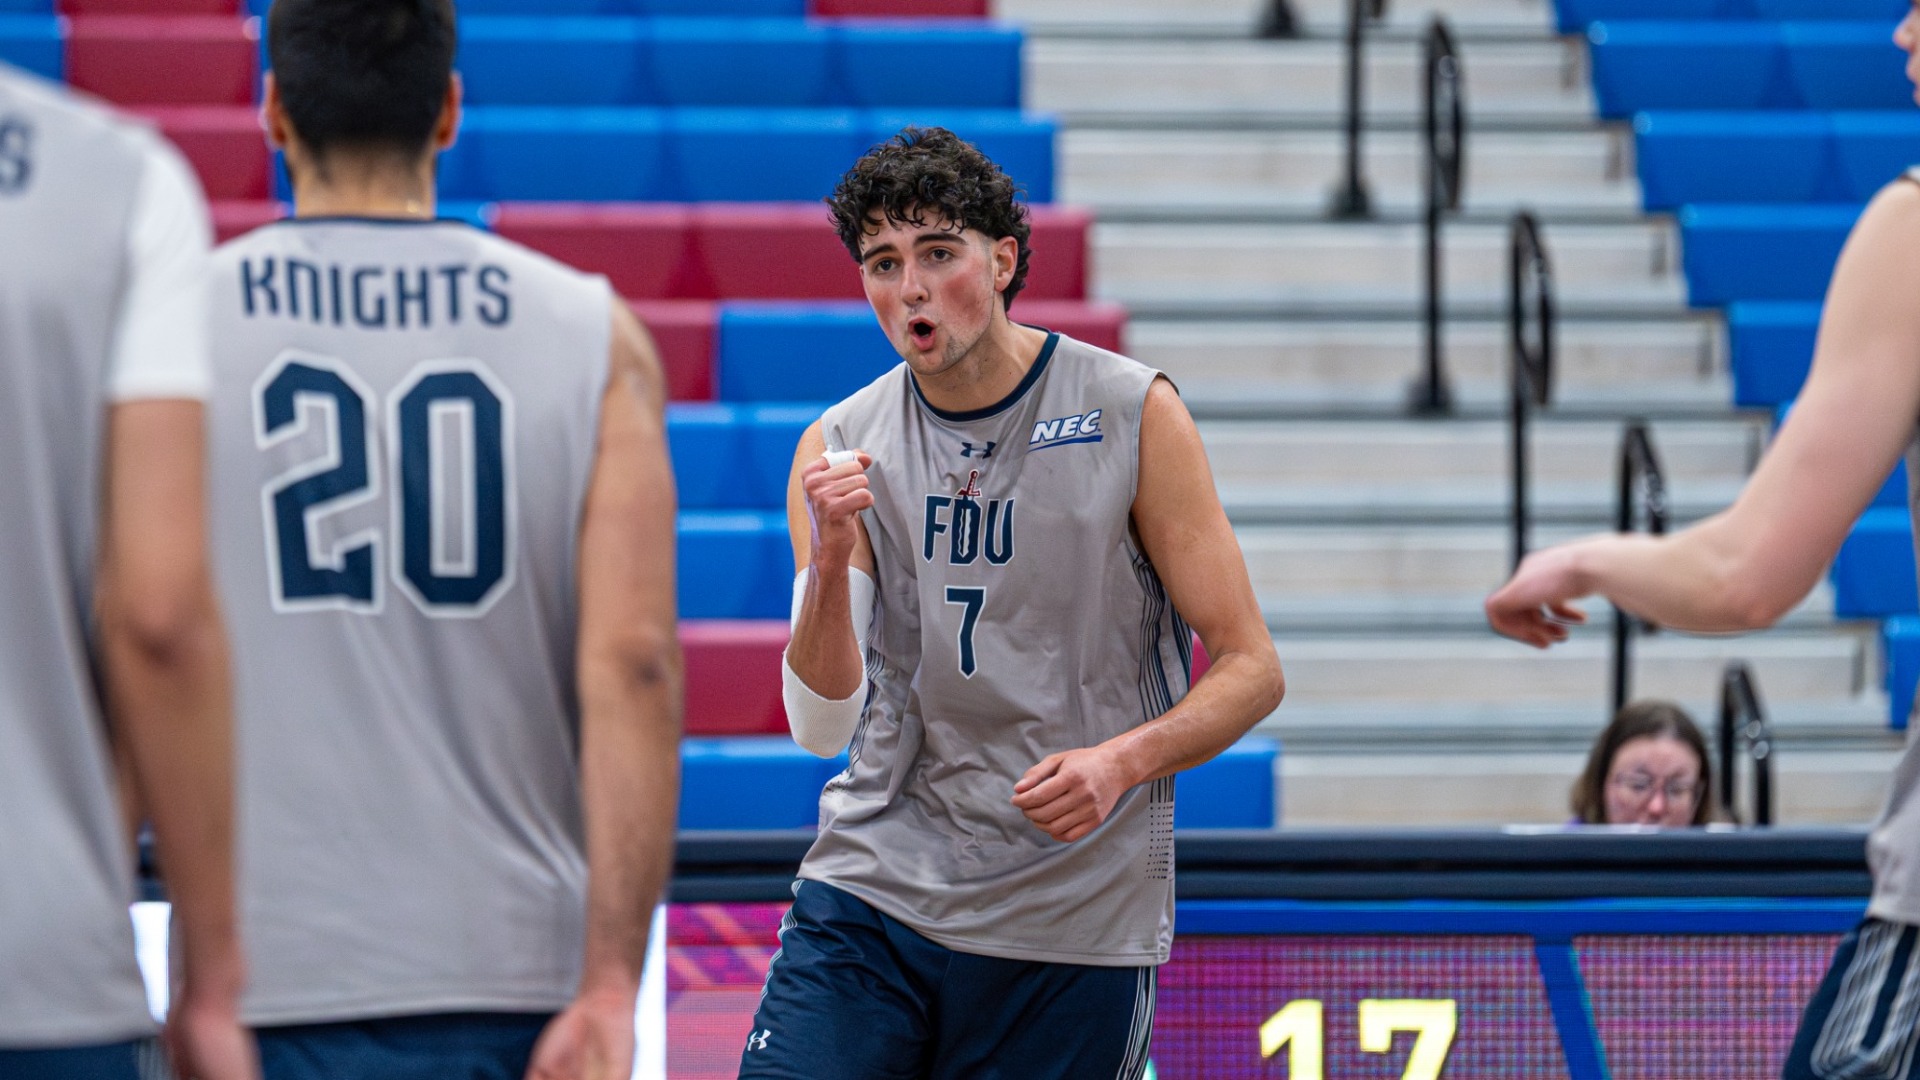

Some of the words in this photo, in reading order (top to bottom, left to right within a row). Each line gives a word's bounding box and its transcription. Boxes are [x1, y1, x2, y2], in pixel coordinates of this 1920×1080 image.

[241, 256, 512, 330] KNIGHTS
[1029, 409, 1102, 445] NEC
[252, 350, 517, 619] 20
[922, 493, 1015, 566] FDU
[945, 585, 987, 680] 7
[1260, 999, 1456, 1080] 17
